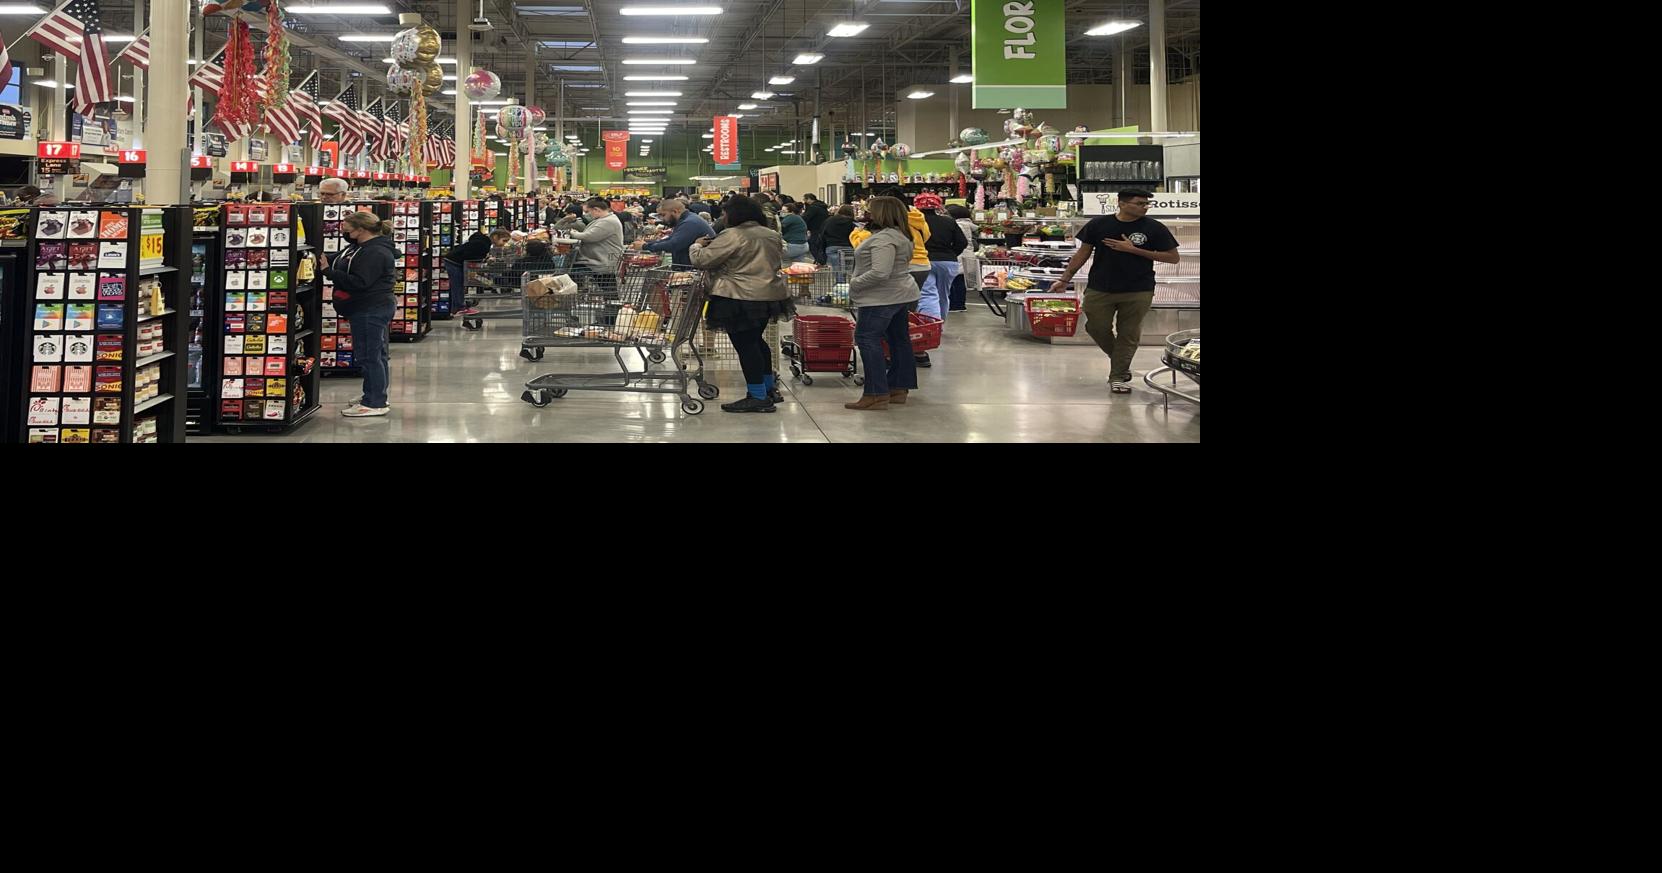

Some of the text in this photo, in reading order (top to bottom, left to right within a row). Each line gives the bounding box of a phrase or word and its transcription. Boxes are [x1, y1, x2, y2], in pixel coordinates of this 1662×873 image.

[719, 118, 730, 160] RESTROOMS
[46, 144, 62, 156] 17
[125, 152, 139, 161] 16
[236, 162, 248, 170] 14
[1149, 200, 1200, 208] Rotiss
